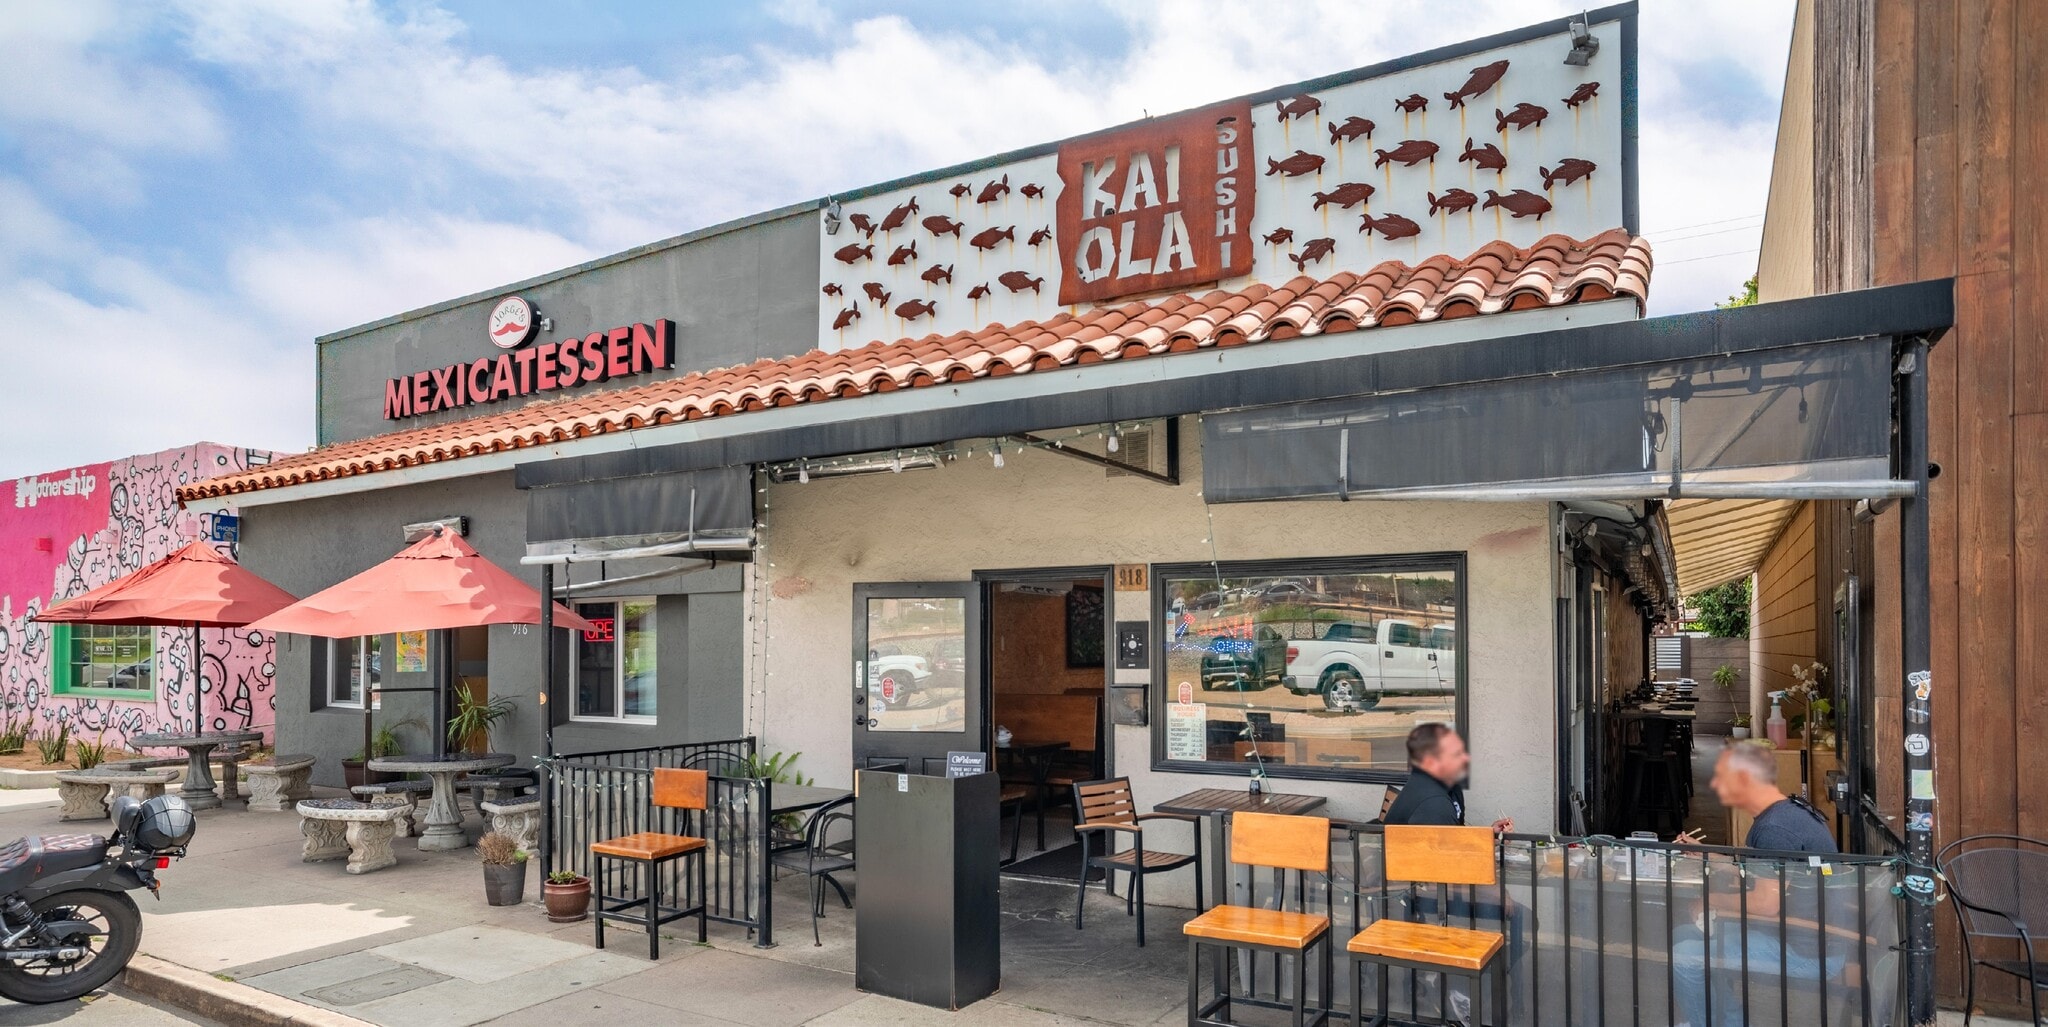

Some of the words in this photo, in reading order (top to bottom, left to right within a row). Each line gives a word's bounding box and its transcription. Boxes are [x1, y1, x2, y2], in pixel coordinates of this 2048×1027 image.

[1080, 144, 1182, 221] KAI
[1214, 116, 1239, 269] SUSHI
[1074, 210, 1197, 284] OLA
[383, 318, 668, 420] MEXICATESSEN
[15, 469, 96, 508] Mothership
[216, 525, 237, 533] PHONE
[1120, 568, 1143, 586] 918
[1216, 640, 1253, 653] OPEN
